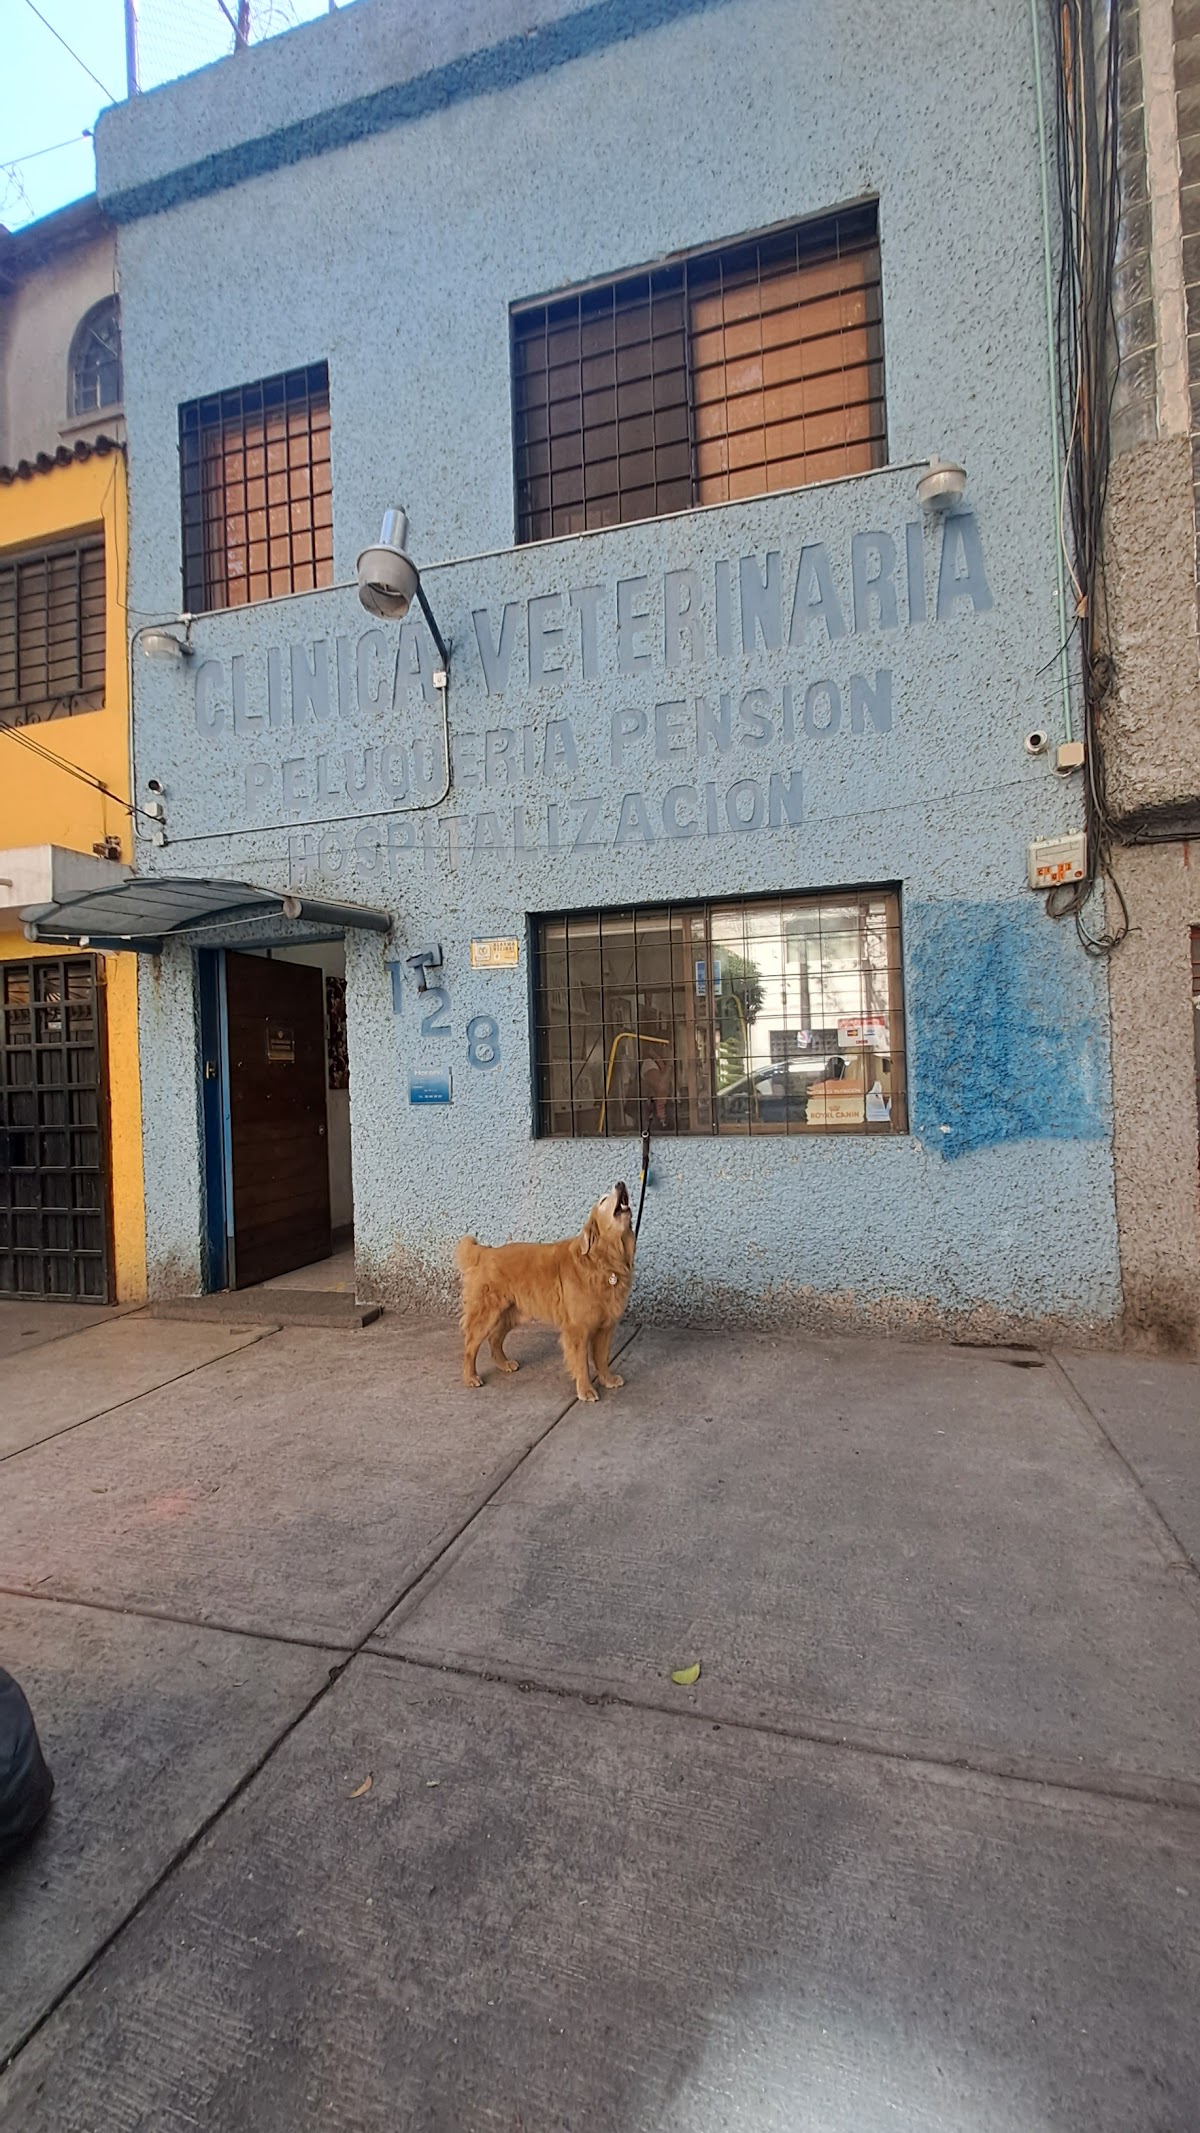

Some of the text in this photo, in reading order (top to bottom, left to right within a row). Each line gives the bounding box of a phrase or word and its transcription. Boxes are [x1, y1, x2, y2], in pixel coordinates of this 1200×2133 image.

[195, 513, 993, 738] CLINICA VETERINARIA
[246, 670, 892, 812] PELUQUERIA PENSION
[288, 771, 804, 886] HOSPITALIZACION
